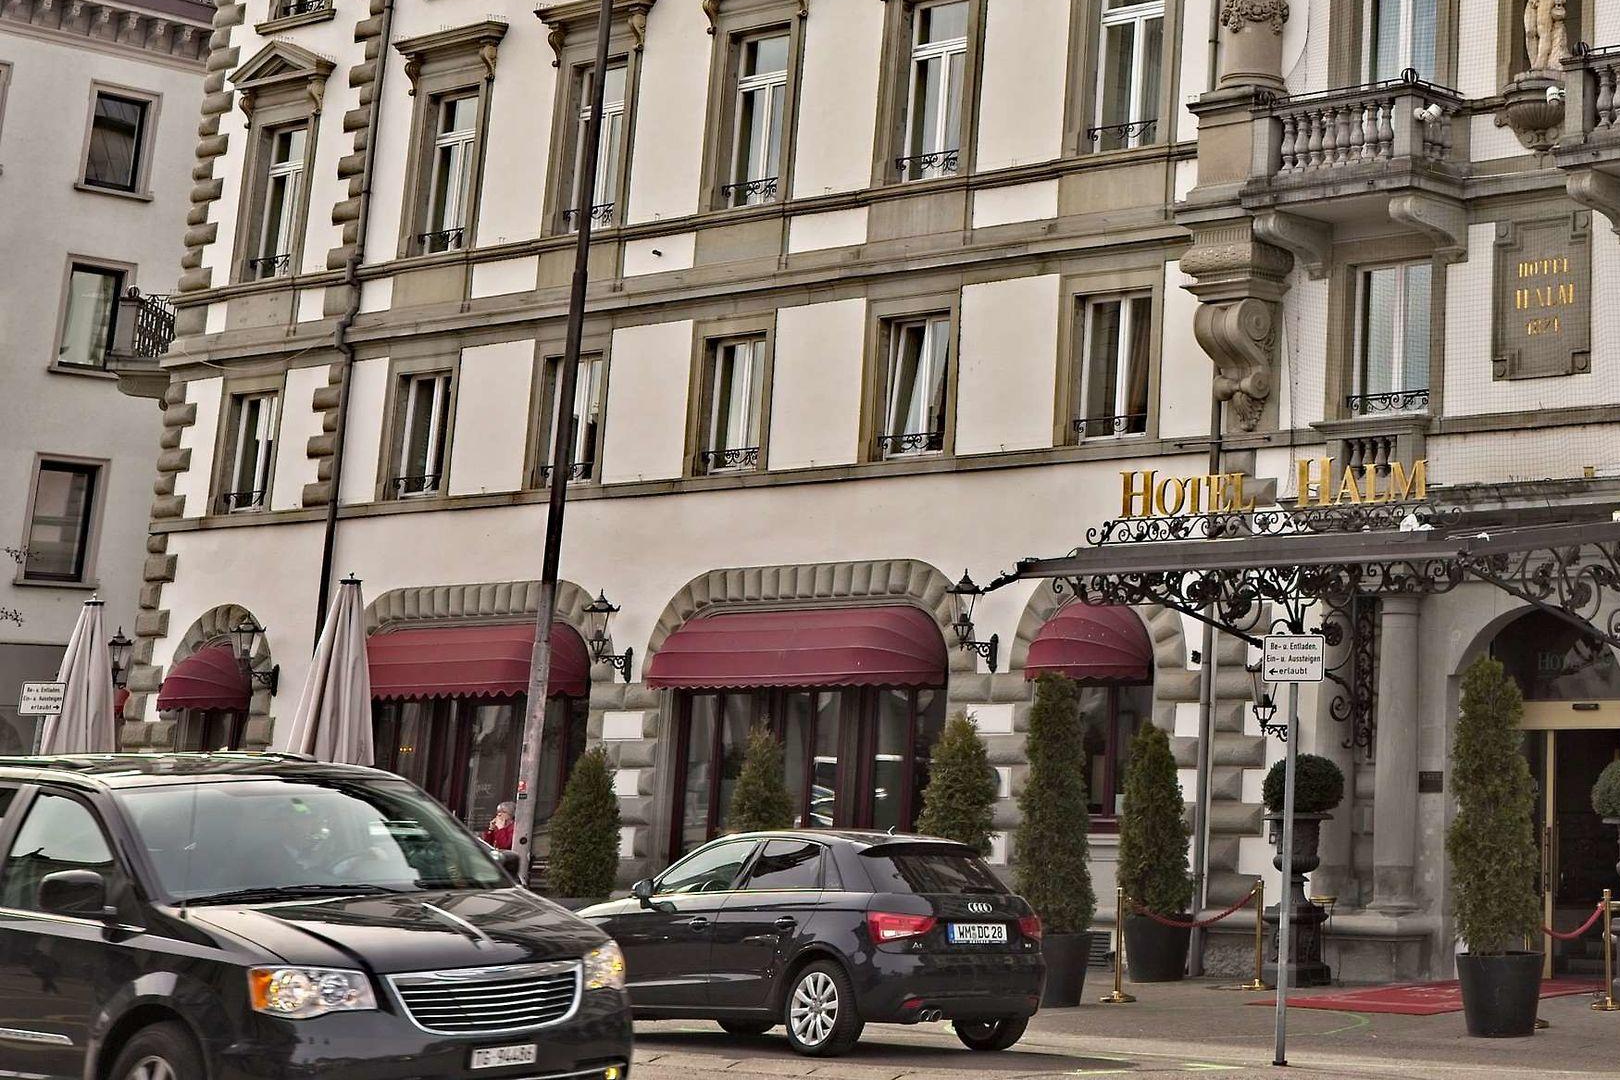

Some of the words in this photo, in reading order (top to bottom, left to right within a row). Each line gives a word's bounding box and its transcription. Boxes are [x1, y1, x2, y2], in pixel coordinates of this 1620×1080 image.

[1518, 258, 1569, 278] HOTEL
[1516, 283, 1574, 309] HALM
[1119, 469, 1256, 518] HOTEL
[1294, 456, 1429, 508] HALM
[1288, 655, 1321, 664] Aussteigen
[1279, 667, 1307, 675] erlaubt
[958, 925, 972, 939] WM
[979, 925, 991, 939] DC
[992, 925, 1003, 939] 28
[912, 941, 923, 949] A1
